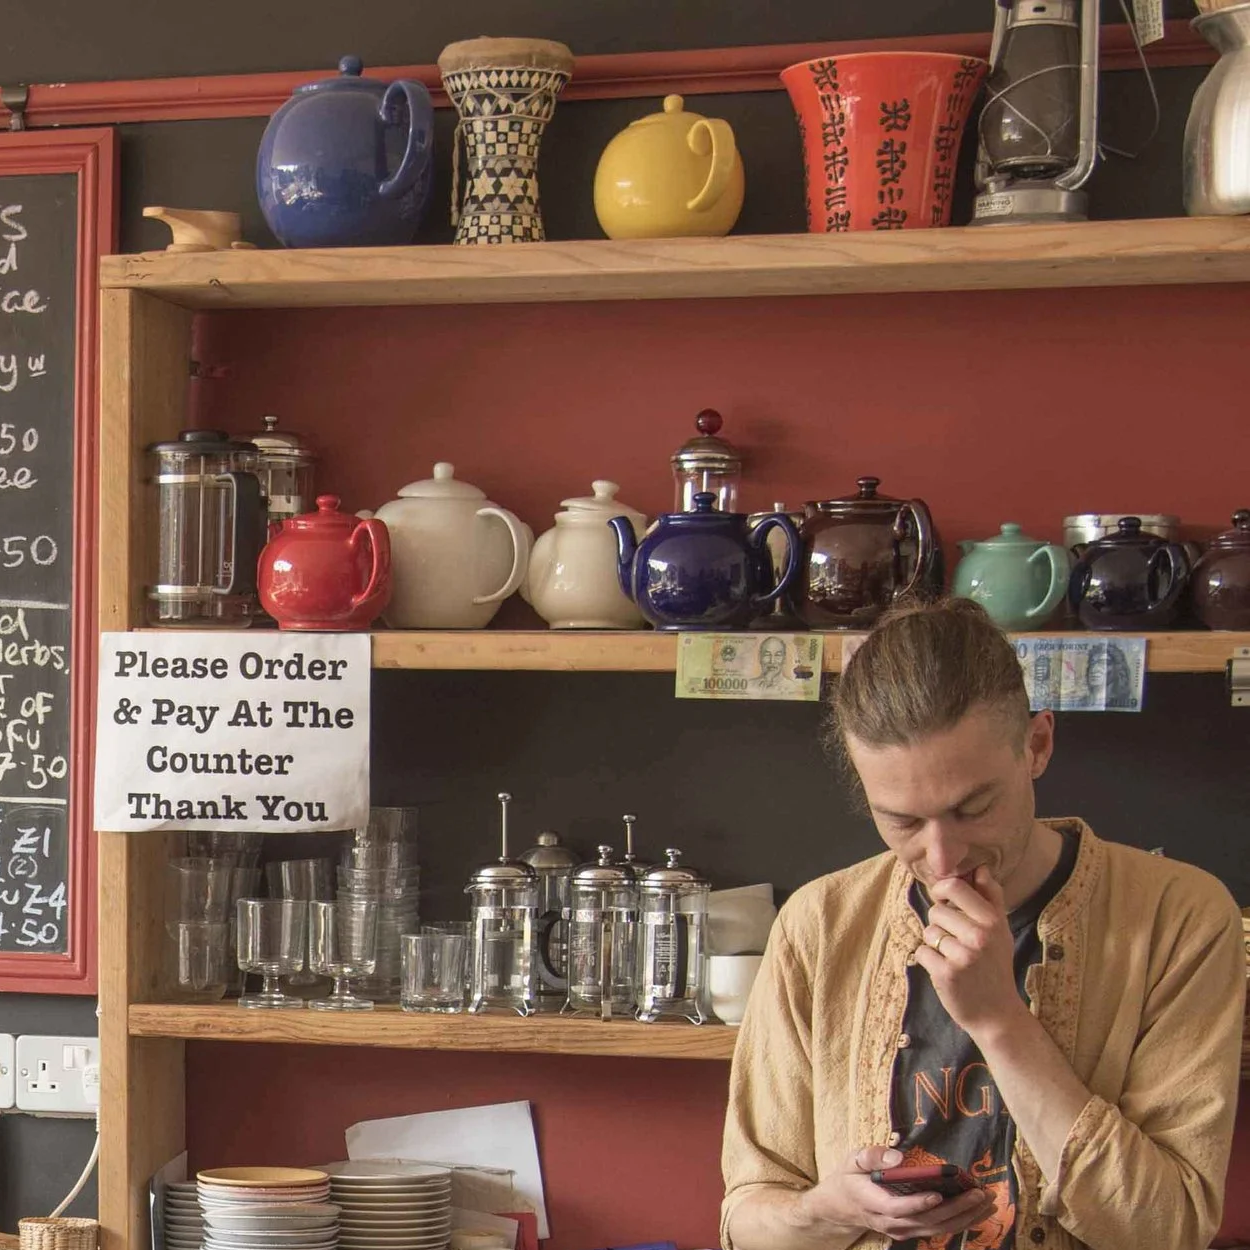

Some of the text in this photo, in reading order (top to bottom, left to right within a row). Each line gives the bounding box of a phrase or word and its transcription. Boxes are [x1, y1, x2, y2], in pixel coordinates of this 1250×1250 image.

[114, 651, 348, 681] Please Order
[113, 698, 354, 734] & Pay At The
[147, 746, 294, 775] Counter
[127, 793, 329, 822] Thank You
[913, 1062, 1009, 1126] NG
